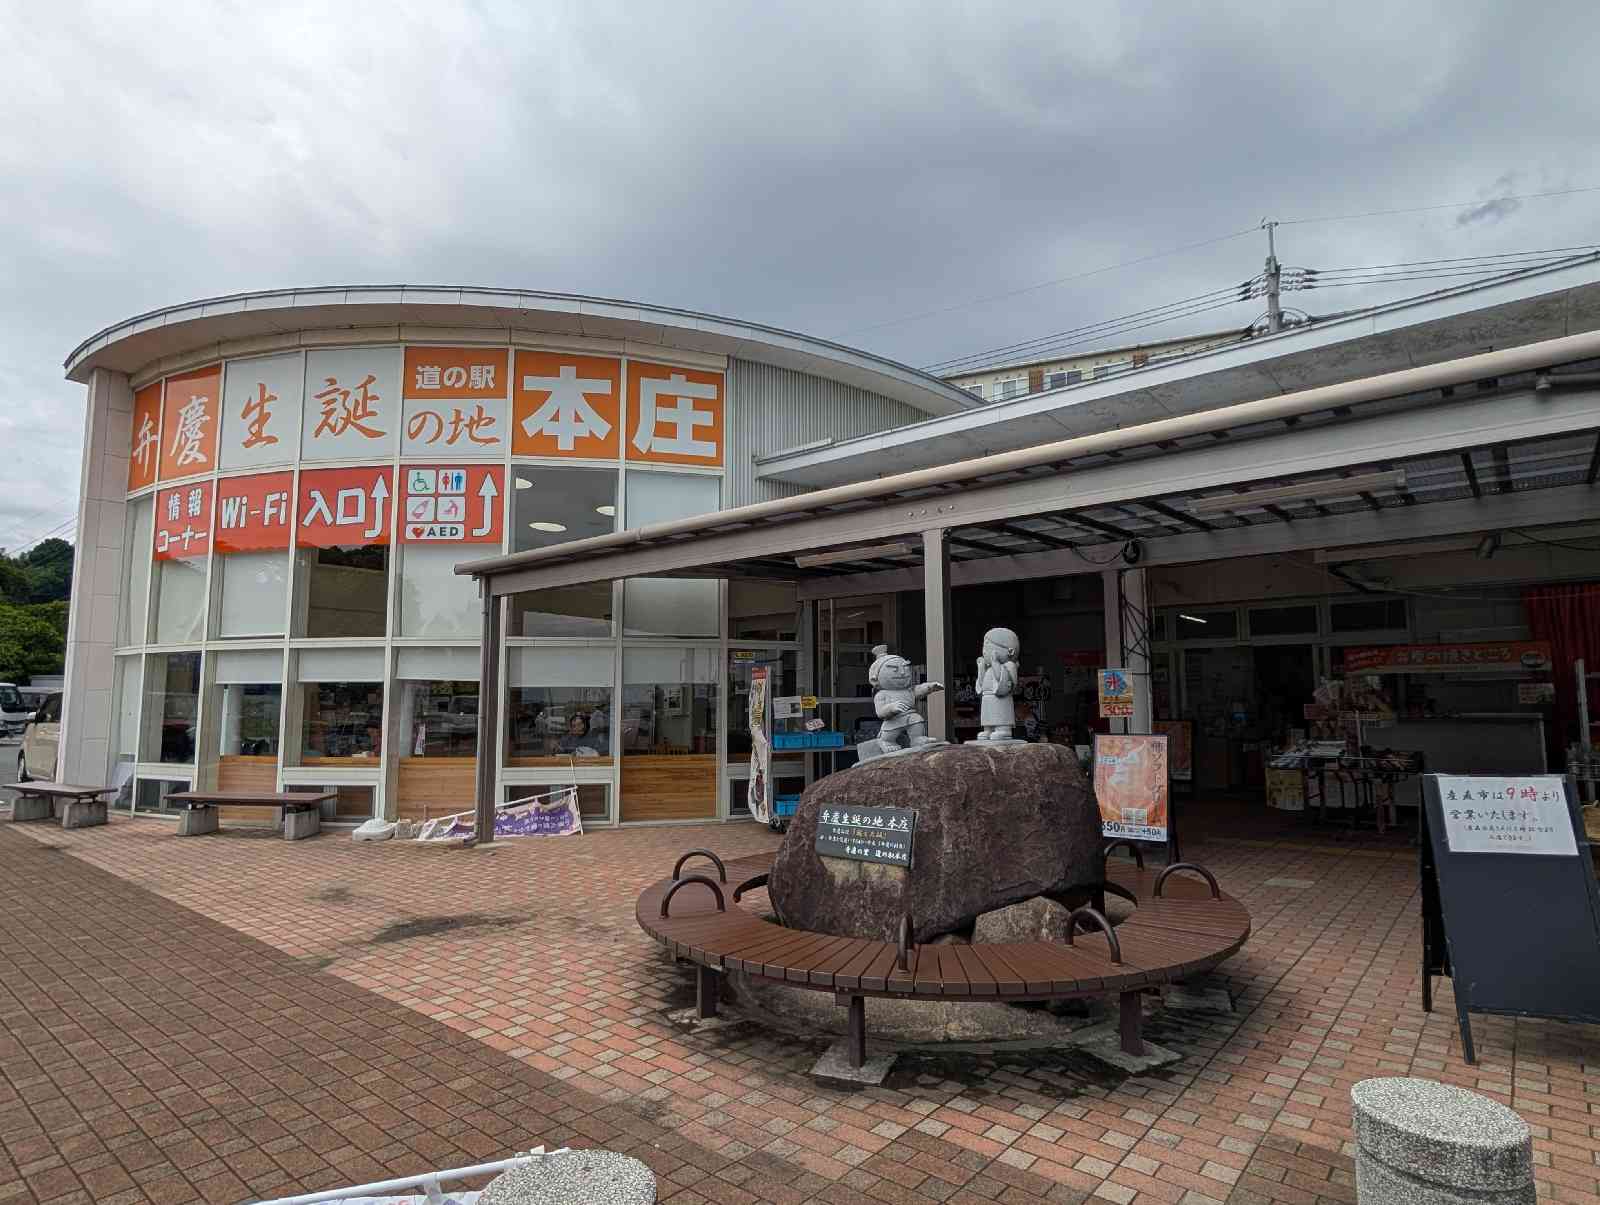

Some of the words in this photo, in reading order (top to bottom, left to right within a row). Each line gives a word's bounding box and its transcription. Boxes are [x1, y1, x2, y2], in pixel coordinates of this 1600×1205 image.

[415, 365, 496, 391] 道の駅
[521, 365, 718, 458] 本庄
[167, 488, 203, 521] 情報
[221, 492, 288, 529] Wi-Fi
[303, 487, 366, 527] 入口
[158, 529, 208, 553] コーナー
[426, 526, 460, 537] AED
